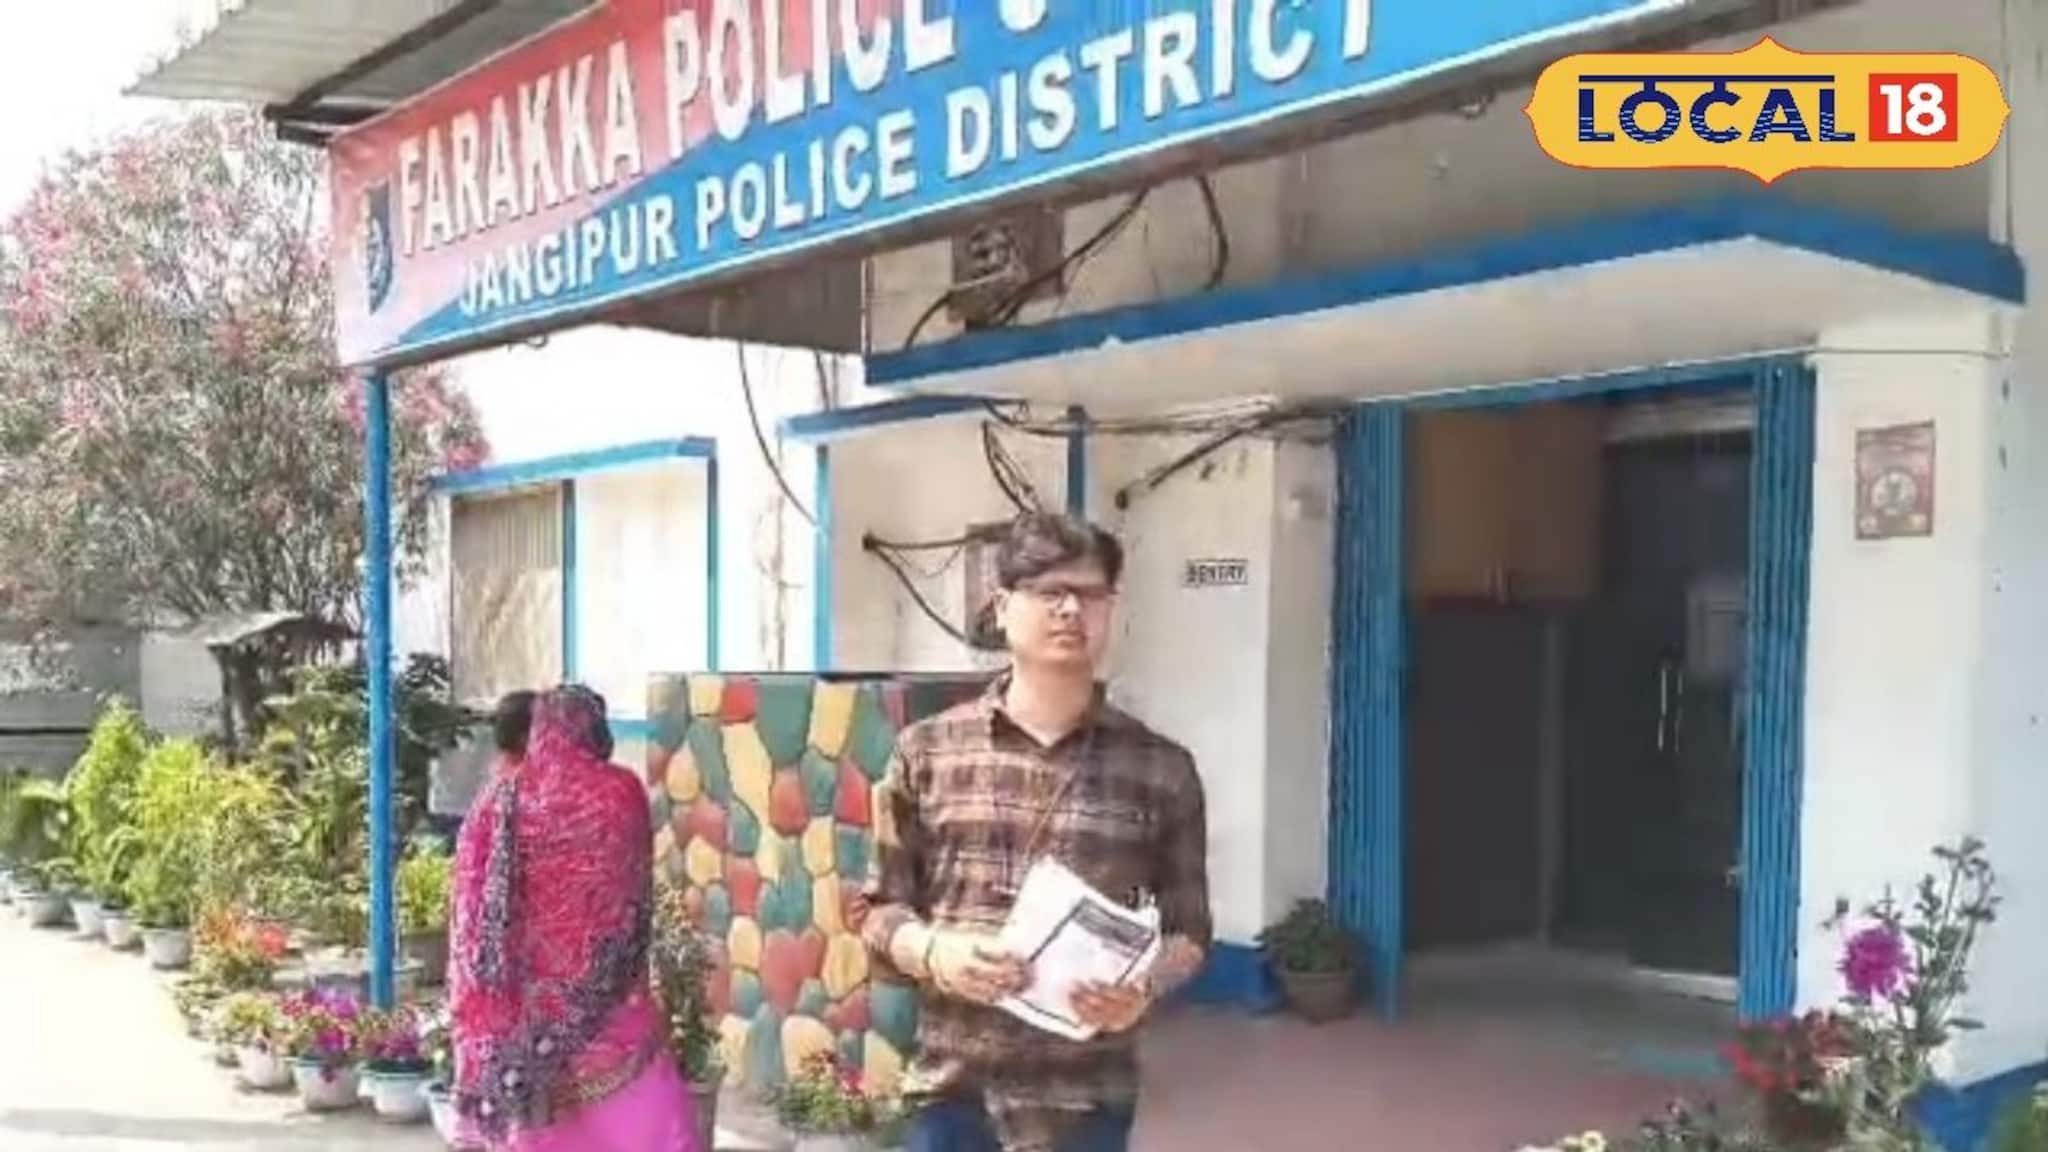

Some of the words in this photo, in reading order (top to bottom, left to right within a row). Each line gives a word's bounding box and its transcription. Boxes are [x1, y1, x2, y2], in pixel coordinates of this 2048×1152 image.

[400, 41, 642, 257] FARAKKA
[458, 194, 677, 316] JANGIPUR
[697, 110, 918, 250] POLICE
